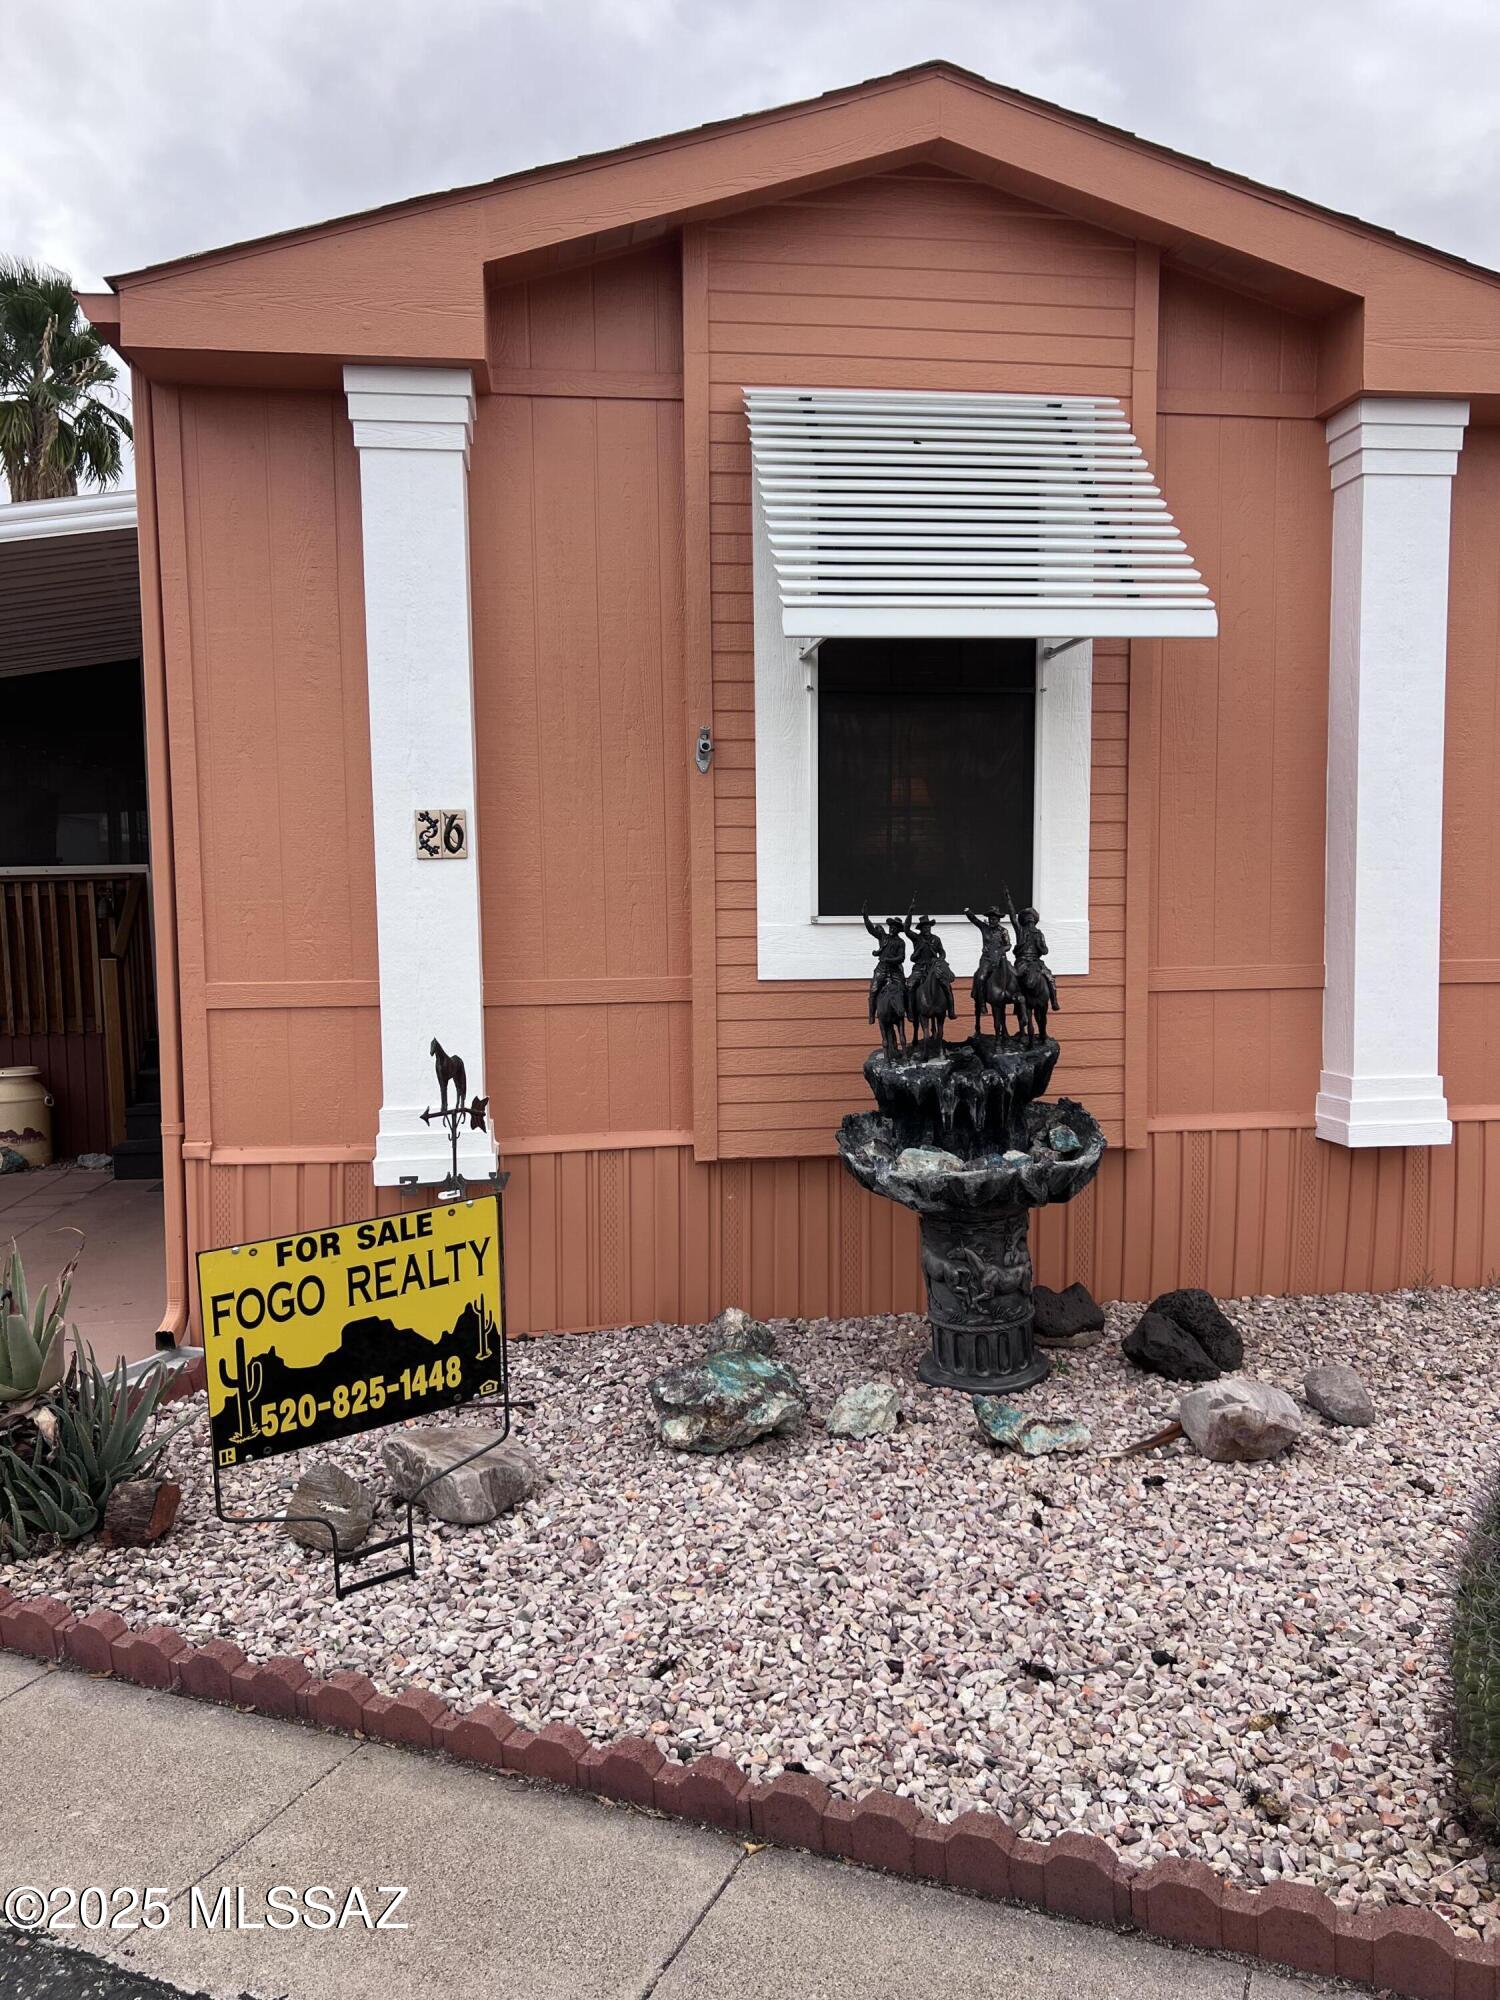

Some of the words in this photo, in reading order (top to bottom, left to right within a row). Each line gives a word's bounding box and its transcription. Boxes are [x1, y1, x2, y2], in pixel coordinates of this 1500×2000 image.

[276, 1231, 341, 1267] FOR
[357, 1212, 433, 1250] SALE
[210, 1275, 325, 1337] FOGO
[346, 1236, 491, 1307] REALTY
[261, 1356, 462, 1437] 520-825-1448
